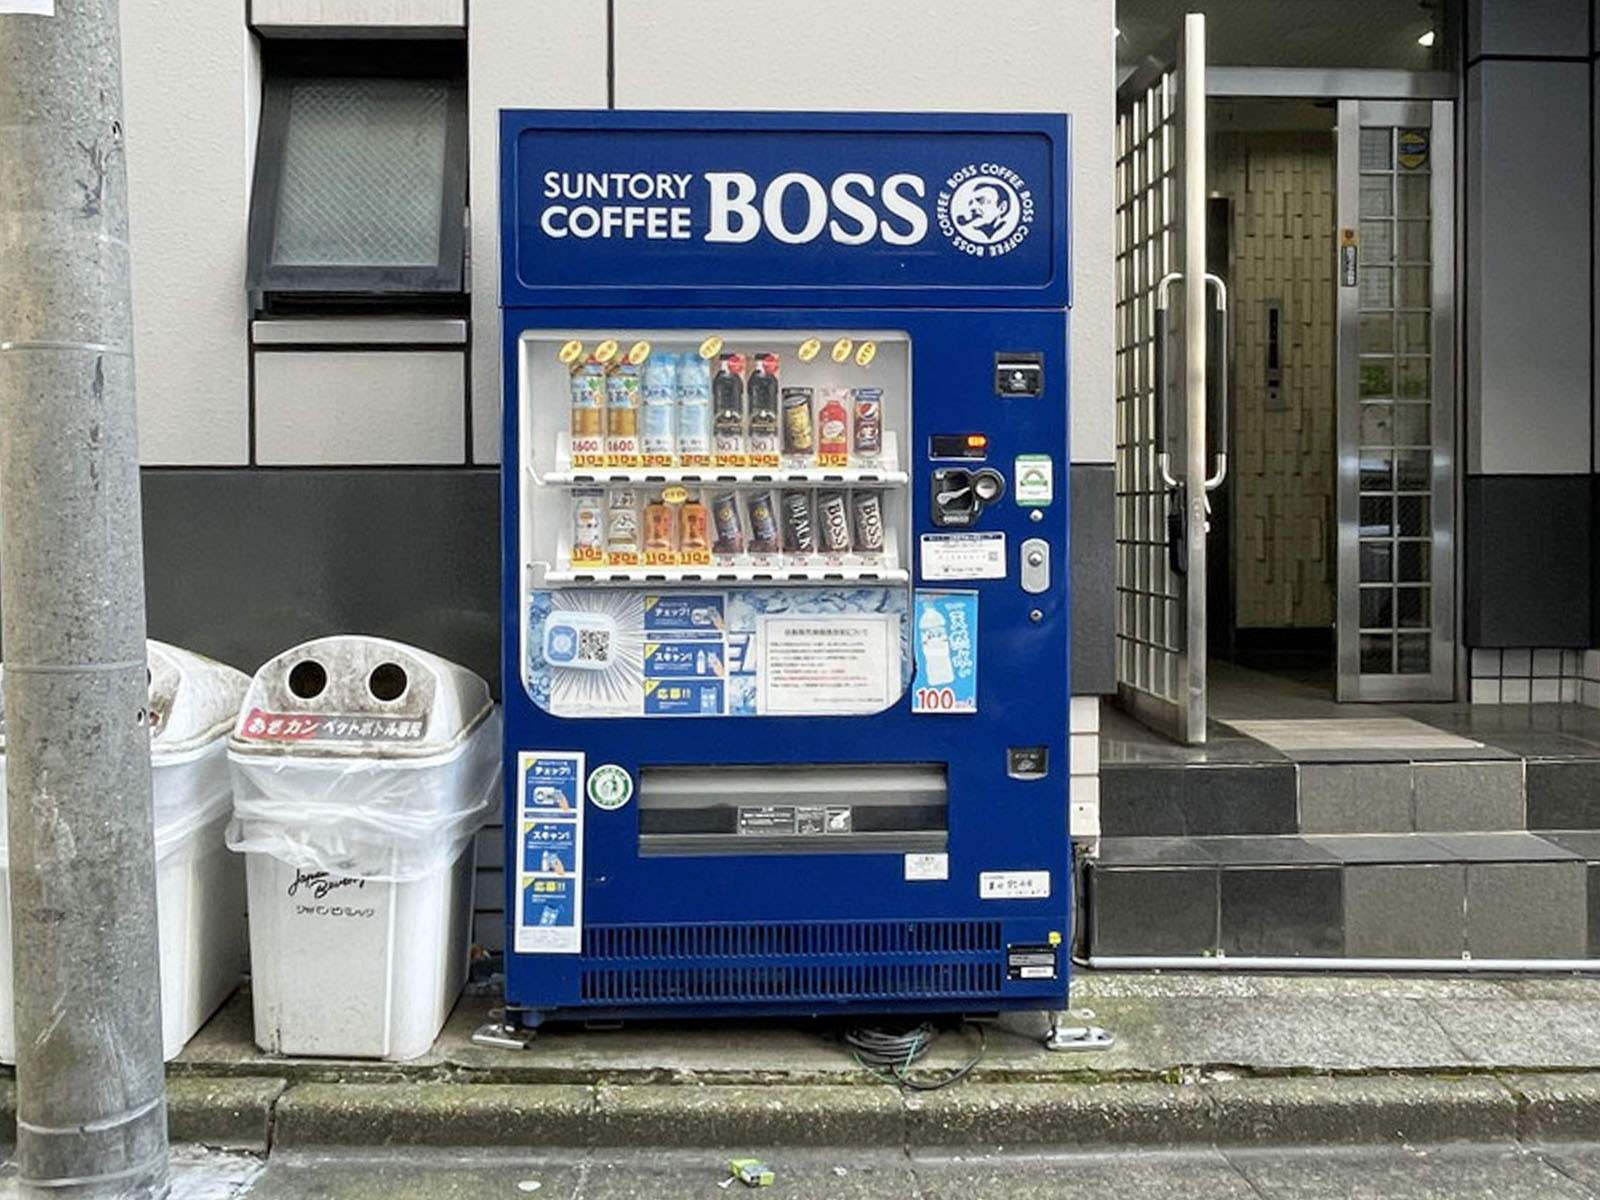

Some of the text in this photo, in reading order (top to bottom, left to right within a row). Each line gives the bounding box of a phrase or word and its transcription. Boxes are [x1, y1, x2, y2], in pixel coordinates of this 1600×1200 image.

[543, 171, 692, 199] SUNTORY
[541, 205, 691, 239] COFFEE
[704, 172, 928, 246] BOSS
[937, 163, 1034, 257] BOSS COFFEE BOSS COFFEE BOSS COFFEE
[827, 504, 848, 545] BOSS
[862, 504, 882, 544] BOSS
[917, 689, 954, 710] 100
